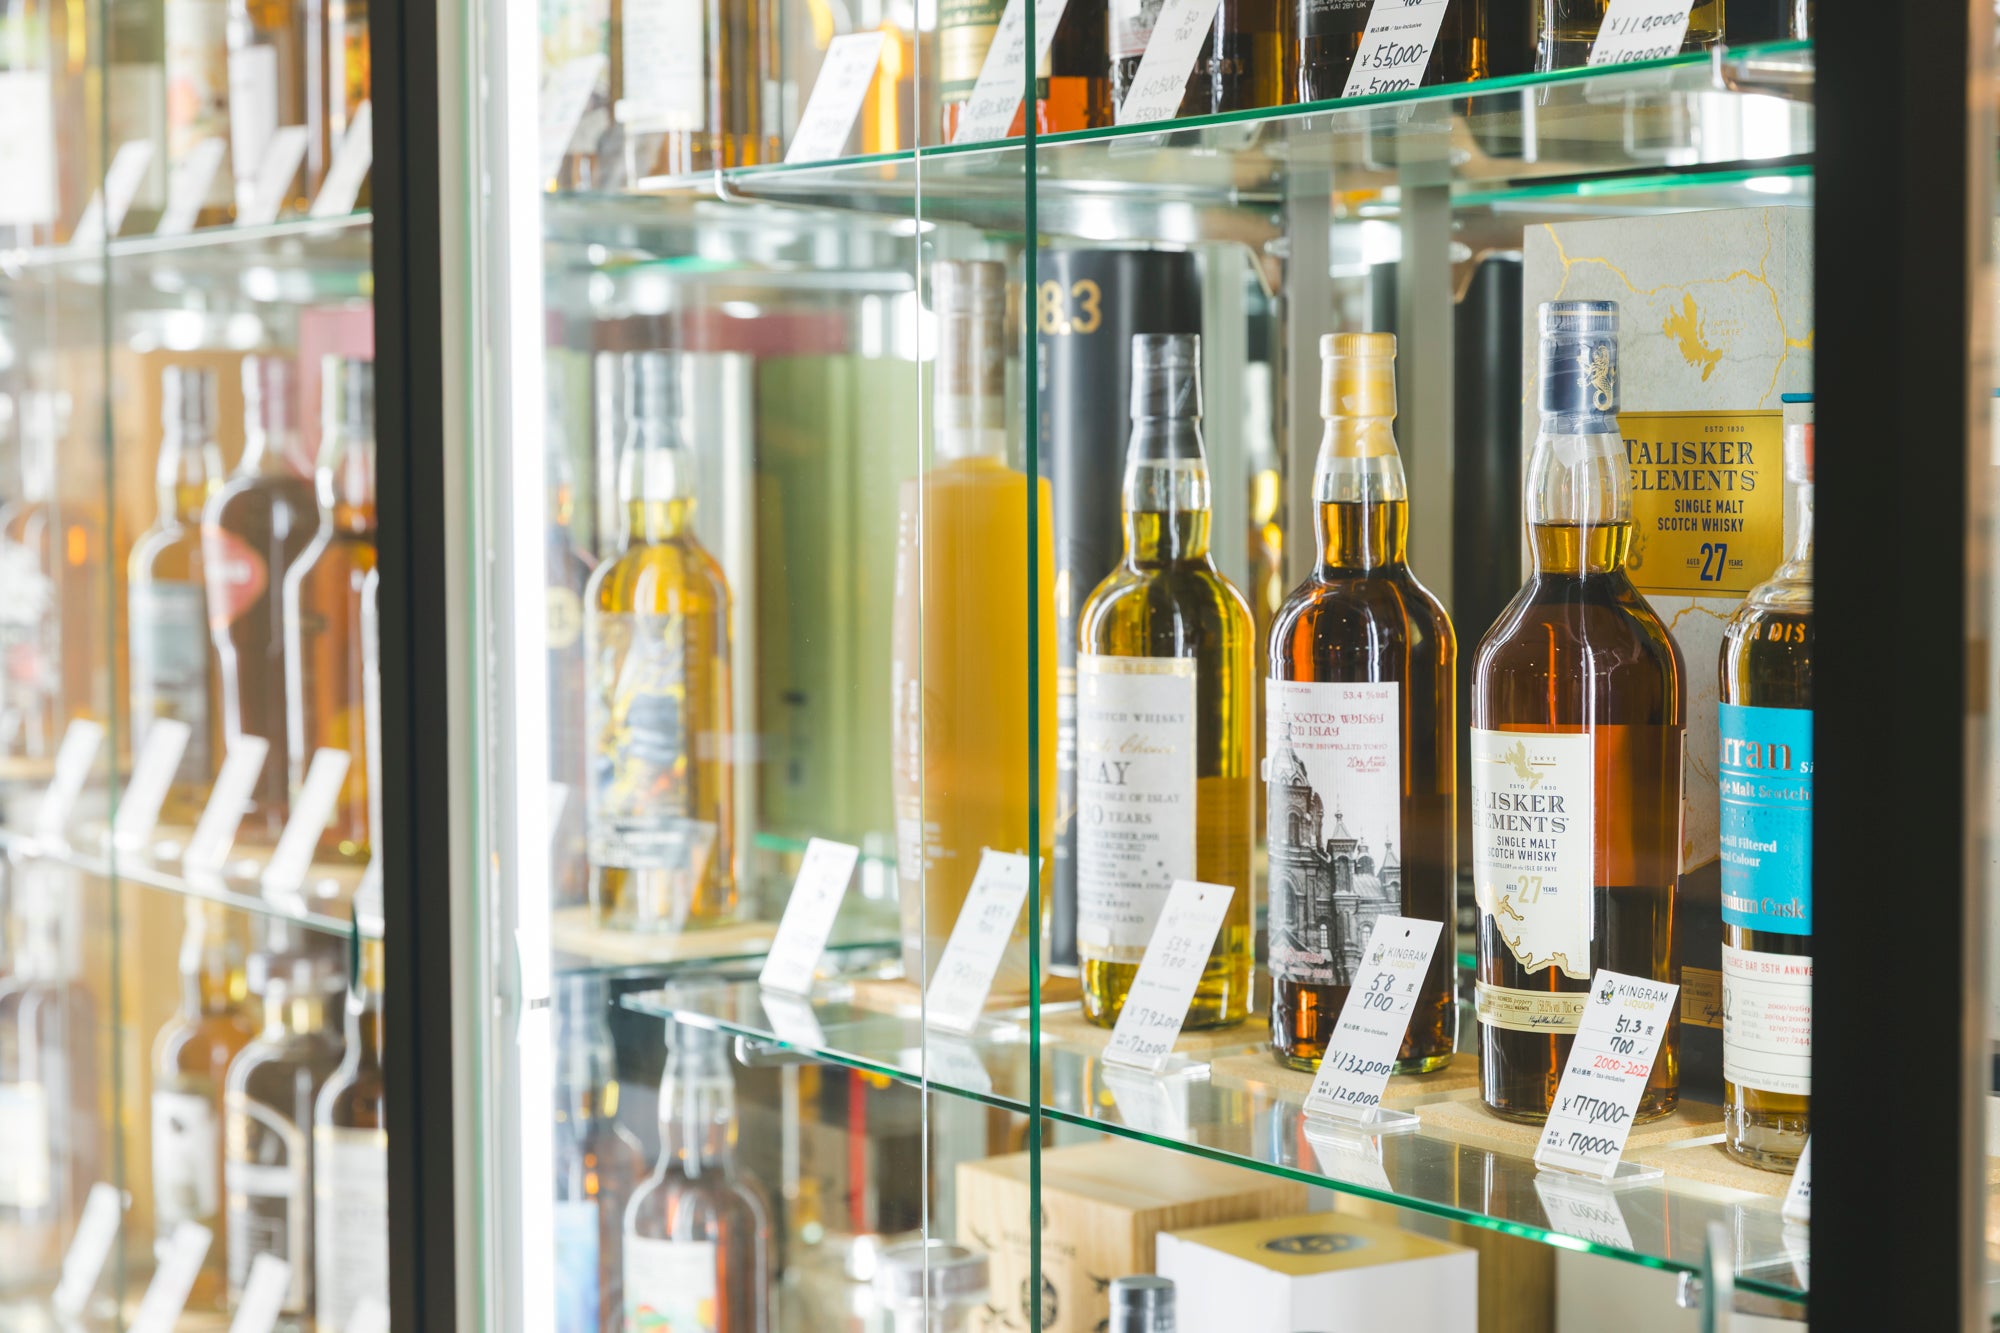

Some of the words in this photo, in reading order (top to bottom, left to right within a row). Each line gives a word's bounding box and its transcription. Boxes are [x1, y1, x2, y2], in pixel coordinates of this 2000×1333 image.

[1674, 499, 1712, 514] SINGLE
[1715, 499, 1744, 514] MALT
[1657, 517, 1698, 531] SCOTCH
[1701, 518, 1744, 532] WHISKY
[1686, 558, 1700, 566] AGED
[1700, 542, 1728, 582] 27
[1728, 559, 1743, 567] YEARS
[1719, 737, 1792, 771] rran
[1731, 780, 1756, 797] Malt
[1758, 785, 1811, 801] Scotch
[1496, 835, 1526, 848] SINGLE
[1529, 838, 1557, 849] MALT
[1738, 837, 1778, 853] Filtered
[1517, 849, 1557, 862] WHISKY
[1731, 852, 1761, 867] Colour
[1517, 874, 1544, 905] 27
[1761, 897, 1806, 919] Cask
[1386, 946, 1428, 962] KINGRAM
[1761, 961, 1781, 974] 35TH
[1370, 972, 1396, 992] 58
[1363, 992, 1394, 1012] 700
[1618, 984, 1669, 1003] KINGRAM
[1623, 999, 1655, 1010] LIQUOR
[1614, 1014, 1642, 1034] 51.3
[1610, 1037, 1635, 1055] 700
